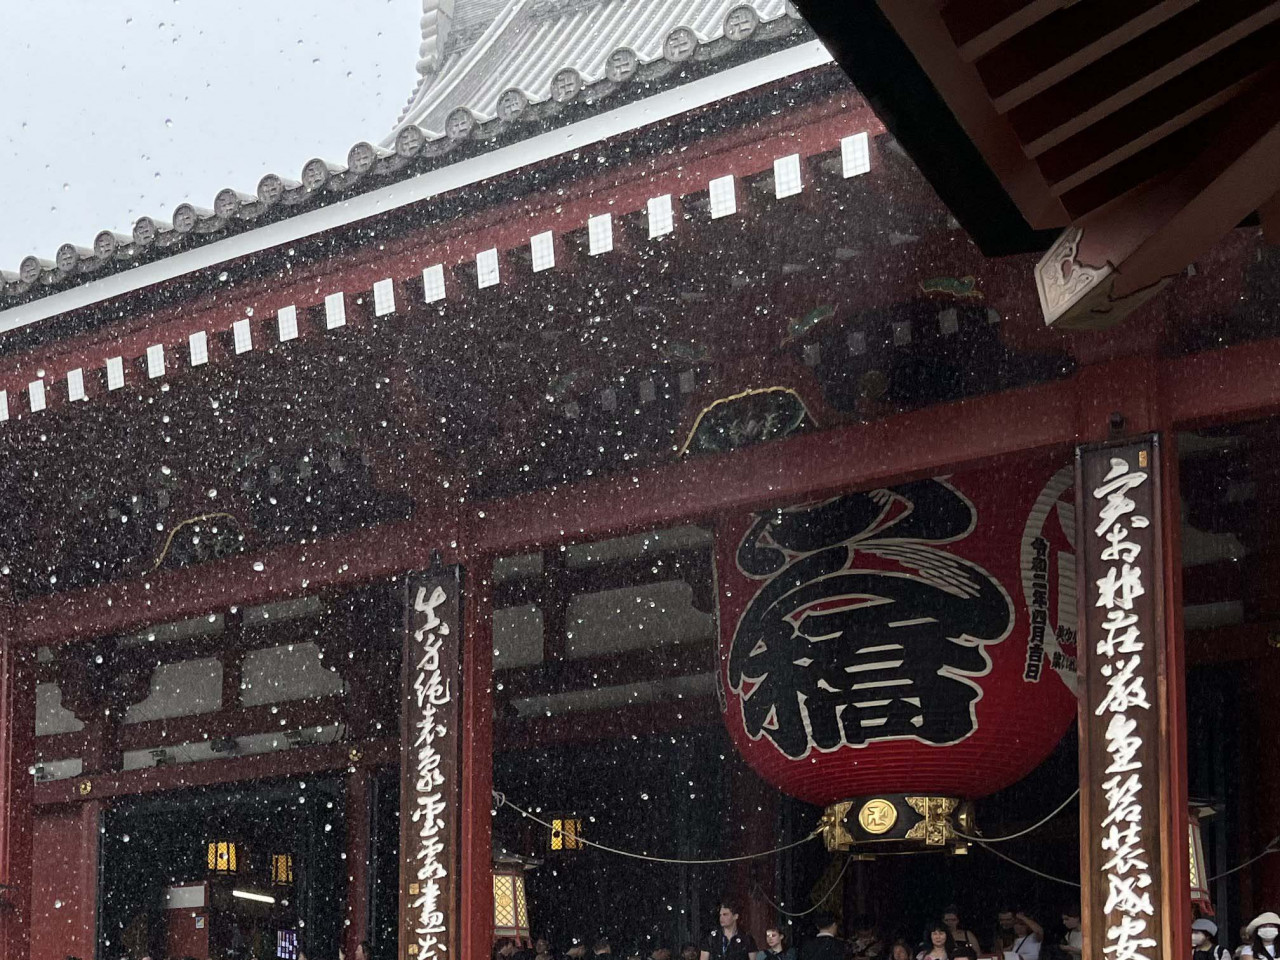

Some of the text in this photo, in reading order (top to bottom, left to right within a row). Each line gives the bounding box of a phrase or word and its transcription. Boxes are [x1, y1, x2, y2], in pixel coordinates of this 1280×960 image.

[1024, 537, 1049, 681] 令和二年四月吉日
